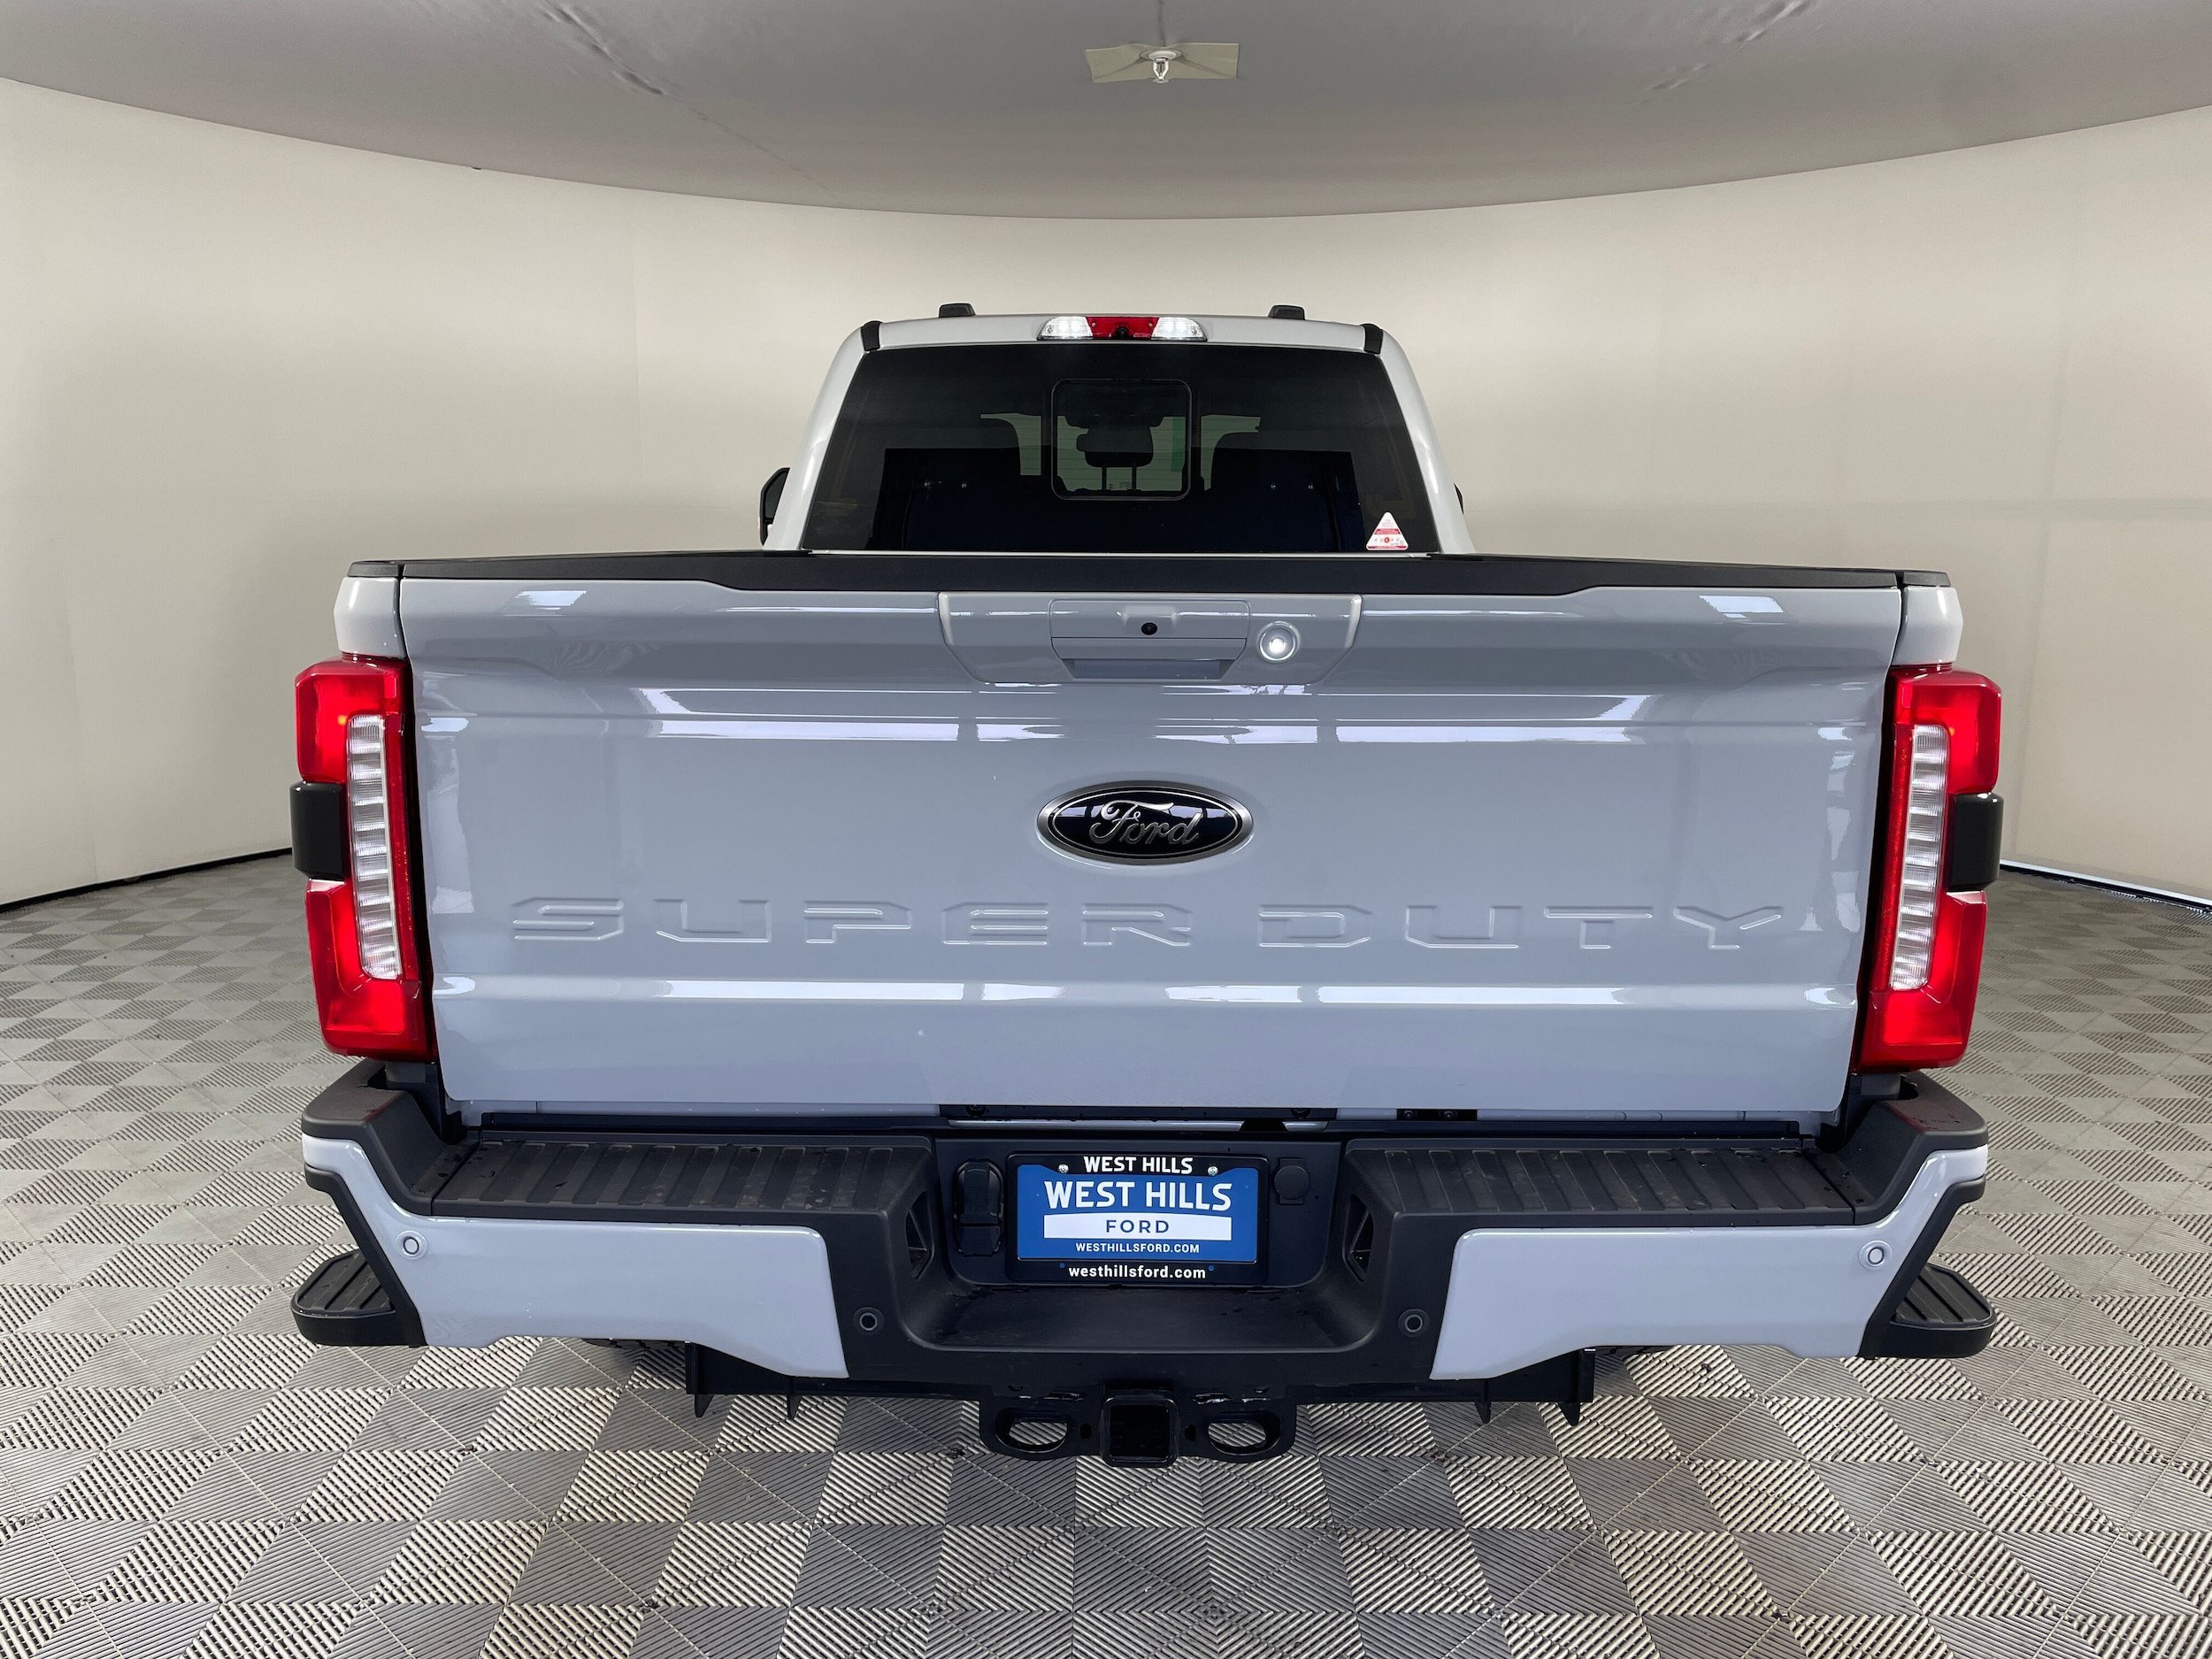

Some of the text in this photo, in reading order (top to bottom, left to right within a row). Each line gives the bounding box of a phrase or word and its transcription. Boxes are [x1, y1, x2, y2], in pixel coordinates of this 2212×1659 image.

[1089, 800, 1204, 845] Ford
[511, 896, 1784, 950] SUPER DUTY
[1083, 1156, 1194, 1175] WEST HILLS
[1044, 1180, 1233, 1212] WEST HILLS
[1106, 1219, 1170, 1233] FORD
[1075, 1242, 1200, 1254] WESTHILLSFORD.COM
[1068, 1264, 1207, 1279] westhillsford.com
